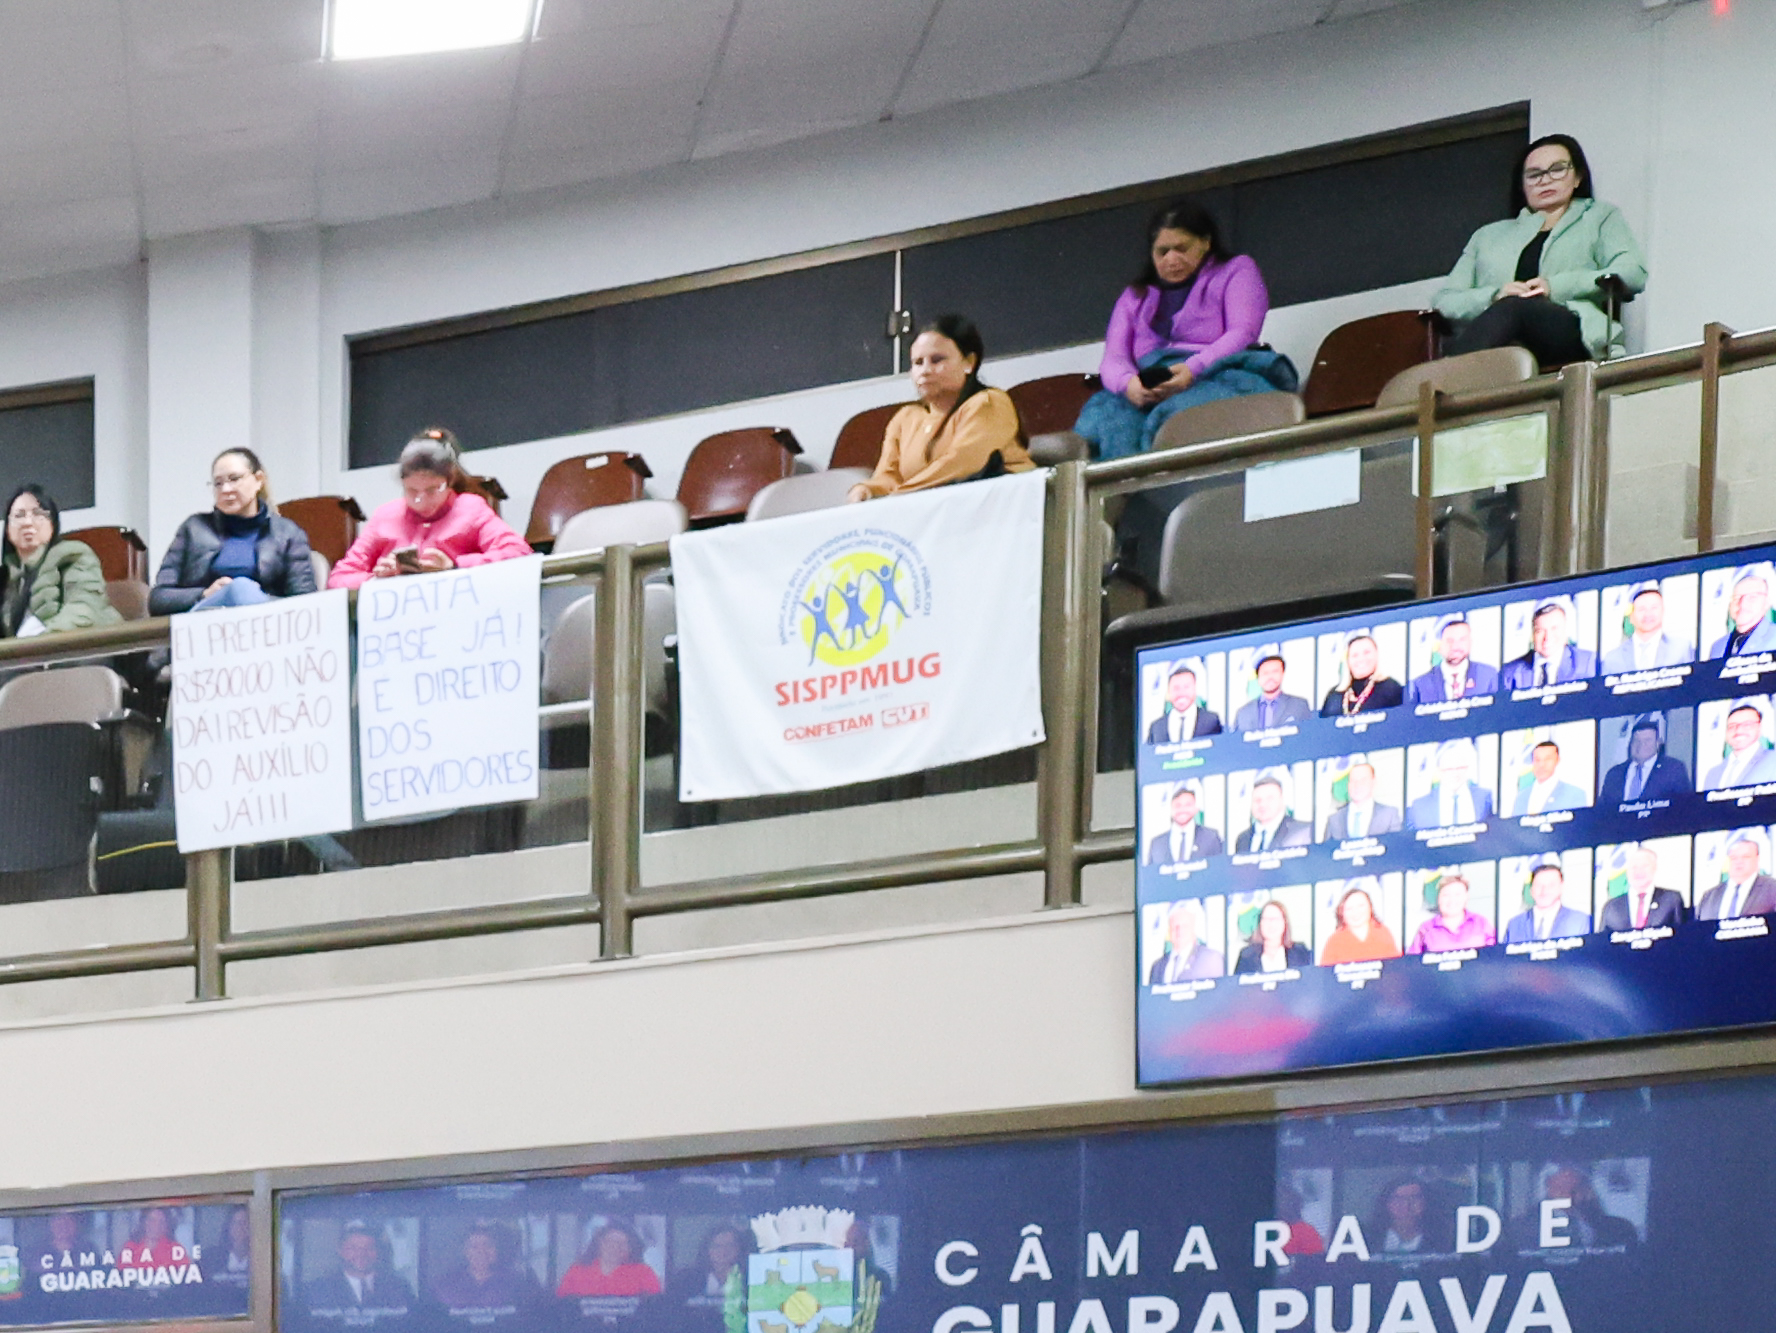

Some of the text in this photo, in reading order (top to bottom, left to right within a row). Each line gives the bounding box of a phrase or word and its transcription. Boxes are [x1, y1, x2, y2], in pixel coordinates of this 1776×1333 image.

[371, 573, 481, 623] DATA
[283, 646, 338, 689] NÃO
[362, 624, 438, 669] BASE
[373, 658, 522, 713] E DIREITO
[774, 651, 942, 708] SISPPMUG
[226, 693, 333, 743] REVISÃO
[367, 718, 433, 760] DOS
[783, 713, 875, 743] CONFETAM
[176, 740, 330, 795] DO AUXÍLIO
[366, 749, 534, 807] SERVIDORES
[40, 1244, 203, 1269] CÂMARA DE
[933, 1198, 1574, 1288] CÂMARA DE
[39, 1264, 204, 1294] GUARAPUAVA
